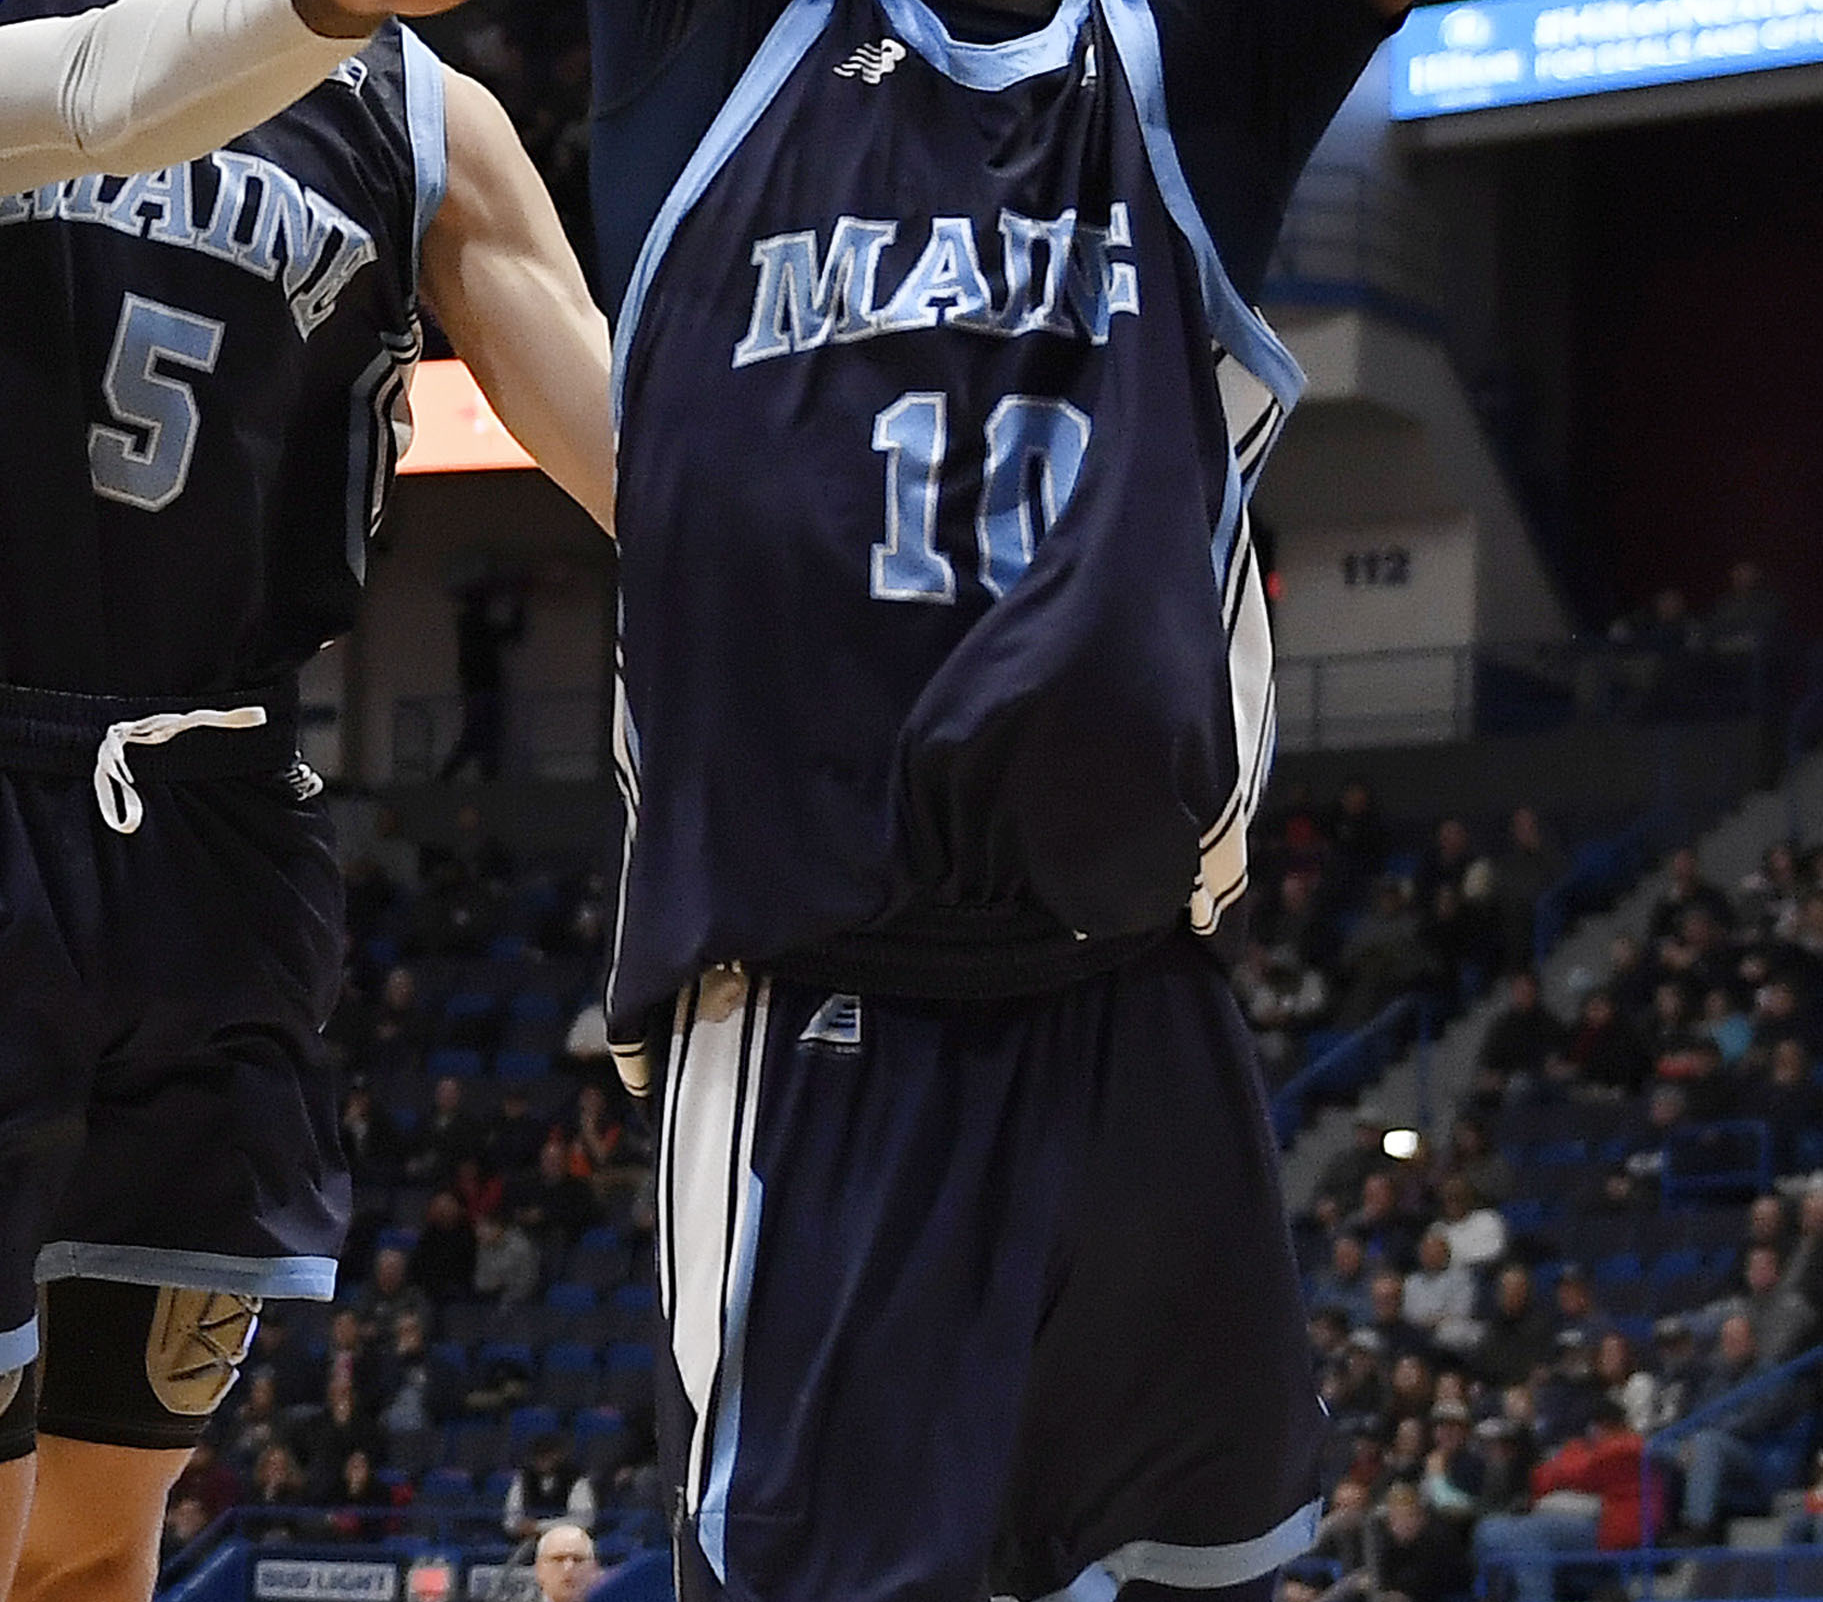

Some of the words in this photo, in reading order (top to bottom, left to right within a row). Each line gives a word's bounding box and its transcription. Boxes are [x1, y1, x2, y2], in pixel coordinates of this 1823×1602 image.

[88, 291, 226, 512] 5
[869, 391, 1093, 605] 10
[1340, 547, 1412, 587] 112
